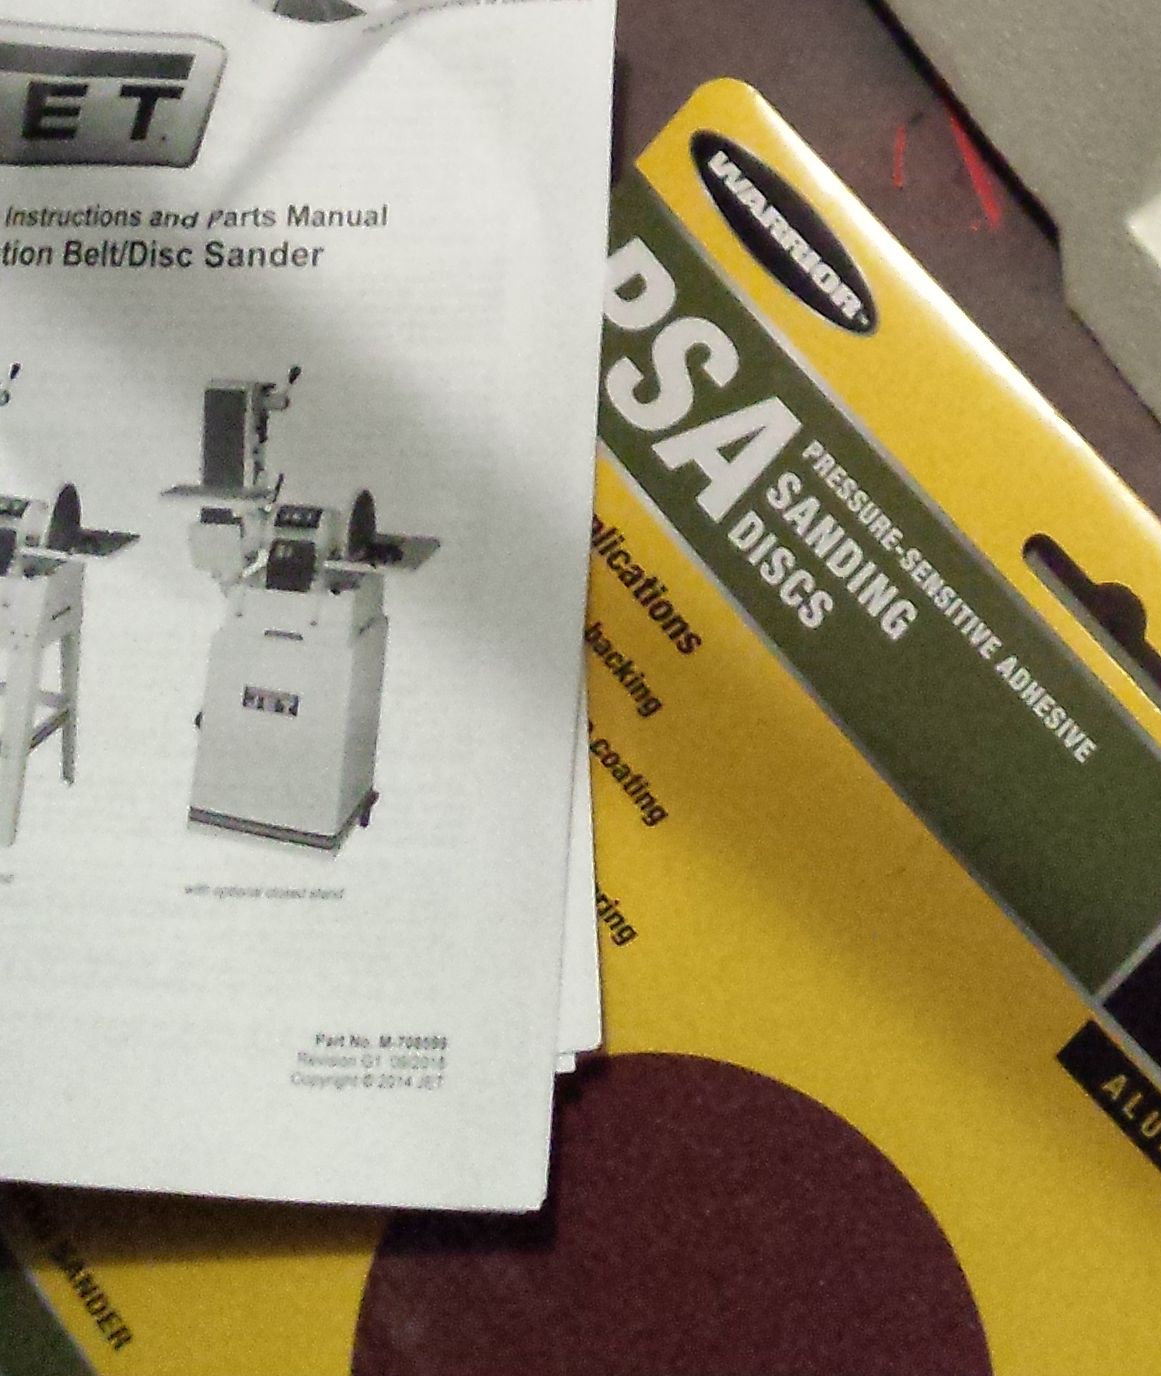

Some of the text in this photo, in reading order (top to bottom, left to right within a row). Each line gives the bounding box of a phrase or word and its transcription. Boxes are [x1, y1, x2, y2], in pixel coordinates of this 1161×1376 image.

[0, 239, 325, 268] tion Belt/Disc Sander
[4, 203, 389, 230] Instructions and Parts Manual
[708, 150, 865, 322] WARRIOR
[602, 238, 802, 523] PSA
[728, 510, 834, 629] DISCS
[766, 472, 918, 641] SANDING
[801, 439, 1097, 764] PRESSURE-SENSITIVE ADHESIVE
[585, 621, 663, 718] backing
[590, 736, 669, 827] coating
[596, 884, 639, 947] ring
